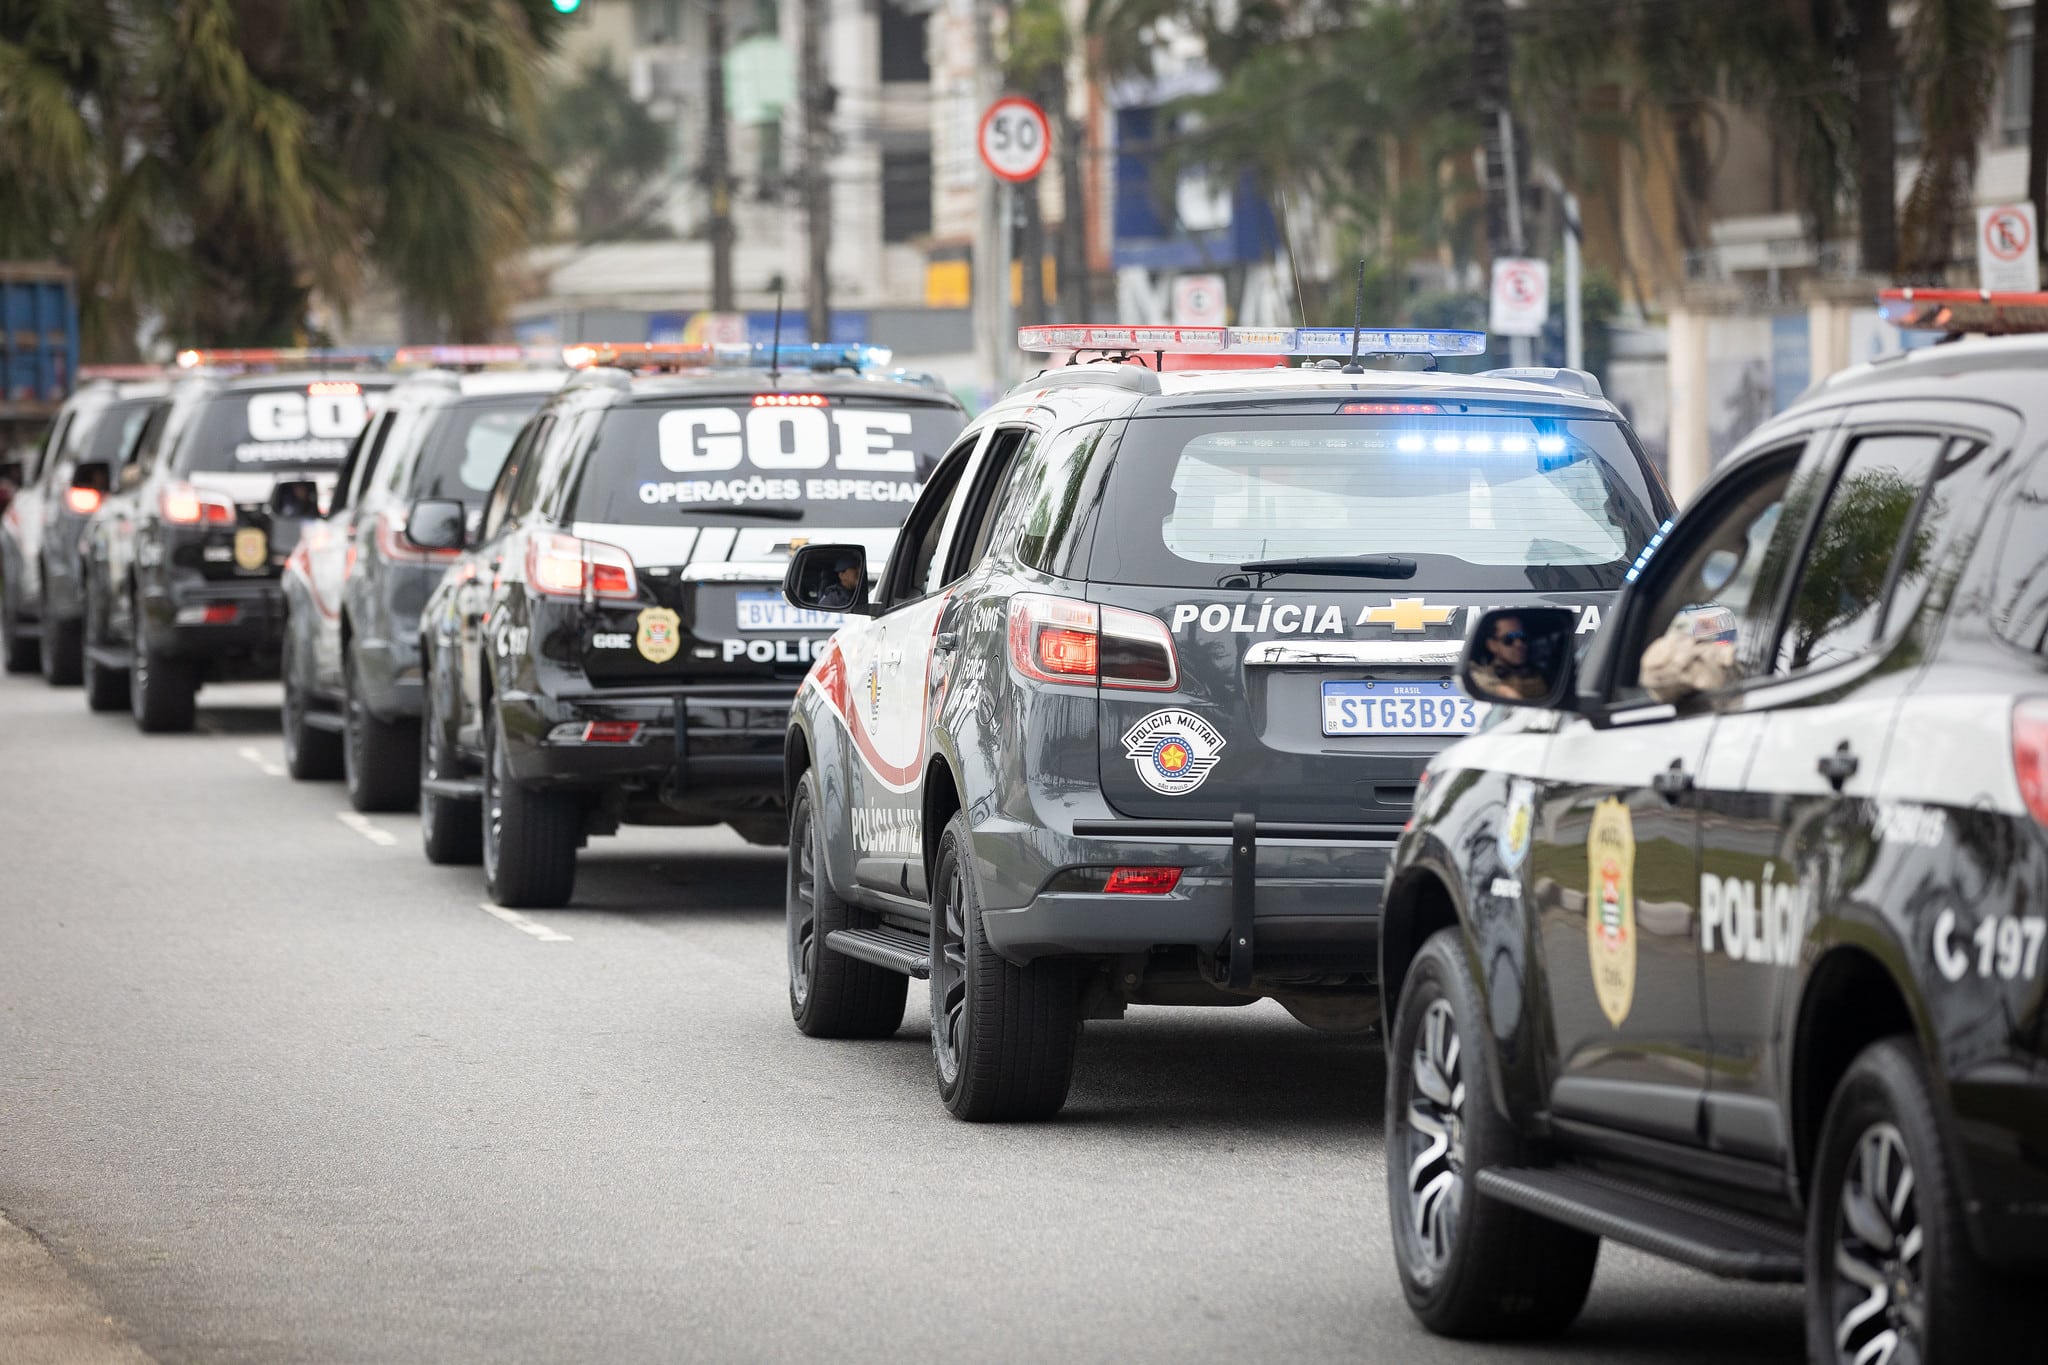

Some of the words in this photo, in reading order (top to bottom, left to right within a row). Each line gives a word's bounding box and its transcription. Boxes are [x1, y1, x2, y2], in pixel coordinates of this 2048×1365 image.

[993, 116, 1037, 151] 50
[658, 407, 916, 472] GOE
[639, 476, 801, 505] OPERAÇÕES
[806, 479, 927, 502] ESPECIAI
[1171, 598, 1344, 634] POLÍCIA
[593, 633, 631, 648] GOE
[1130, 714, 1172, 745] POLÍCIA
[1177, 714, 1217, 747] MILITAR
[1341, 699, 1476, 728] STG3B93
[851, 796, 897, 852] POLÍCIA
[1974, 914, 2047, 981] 197
